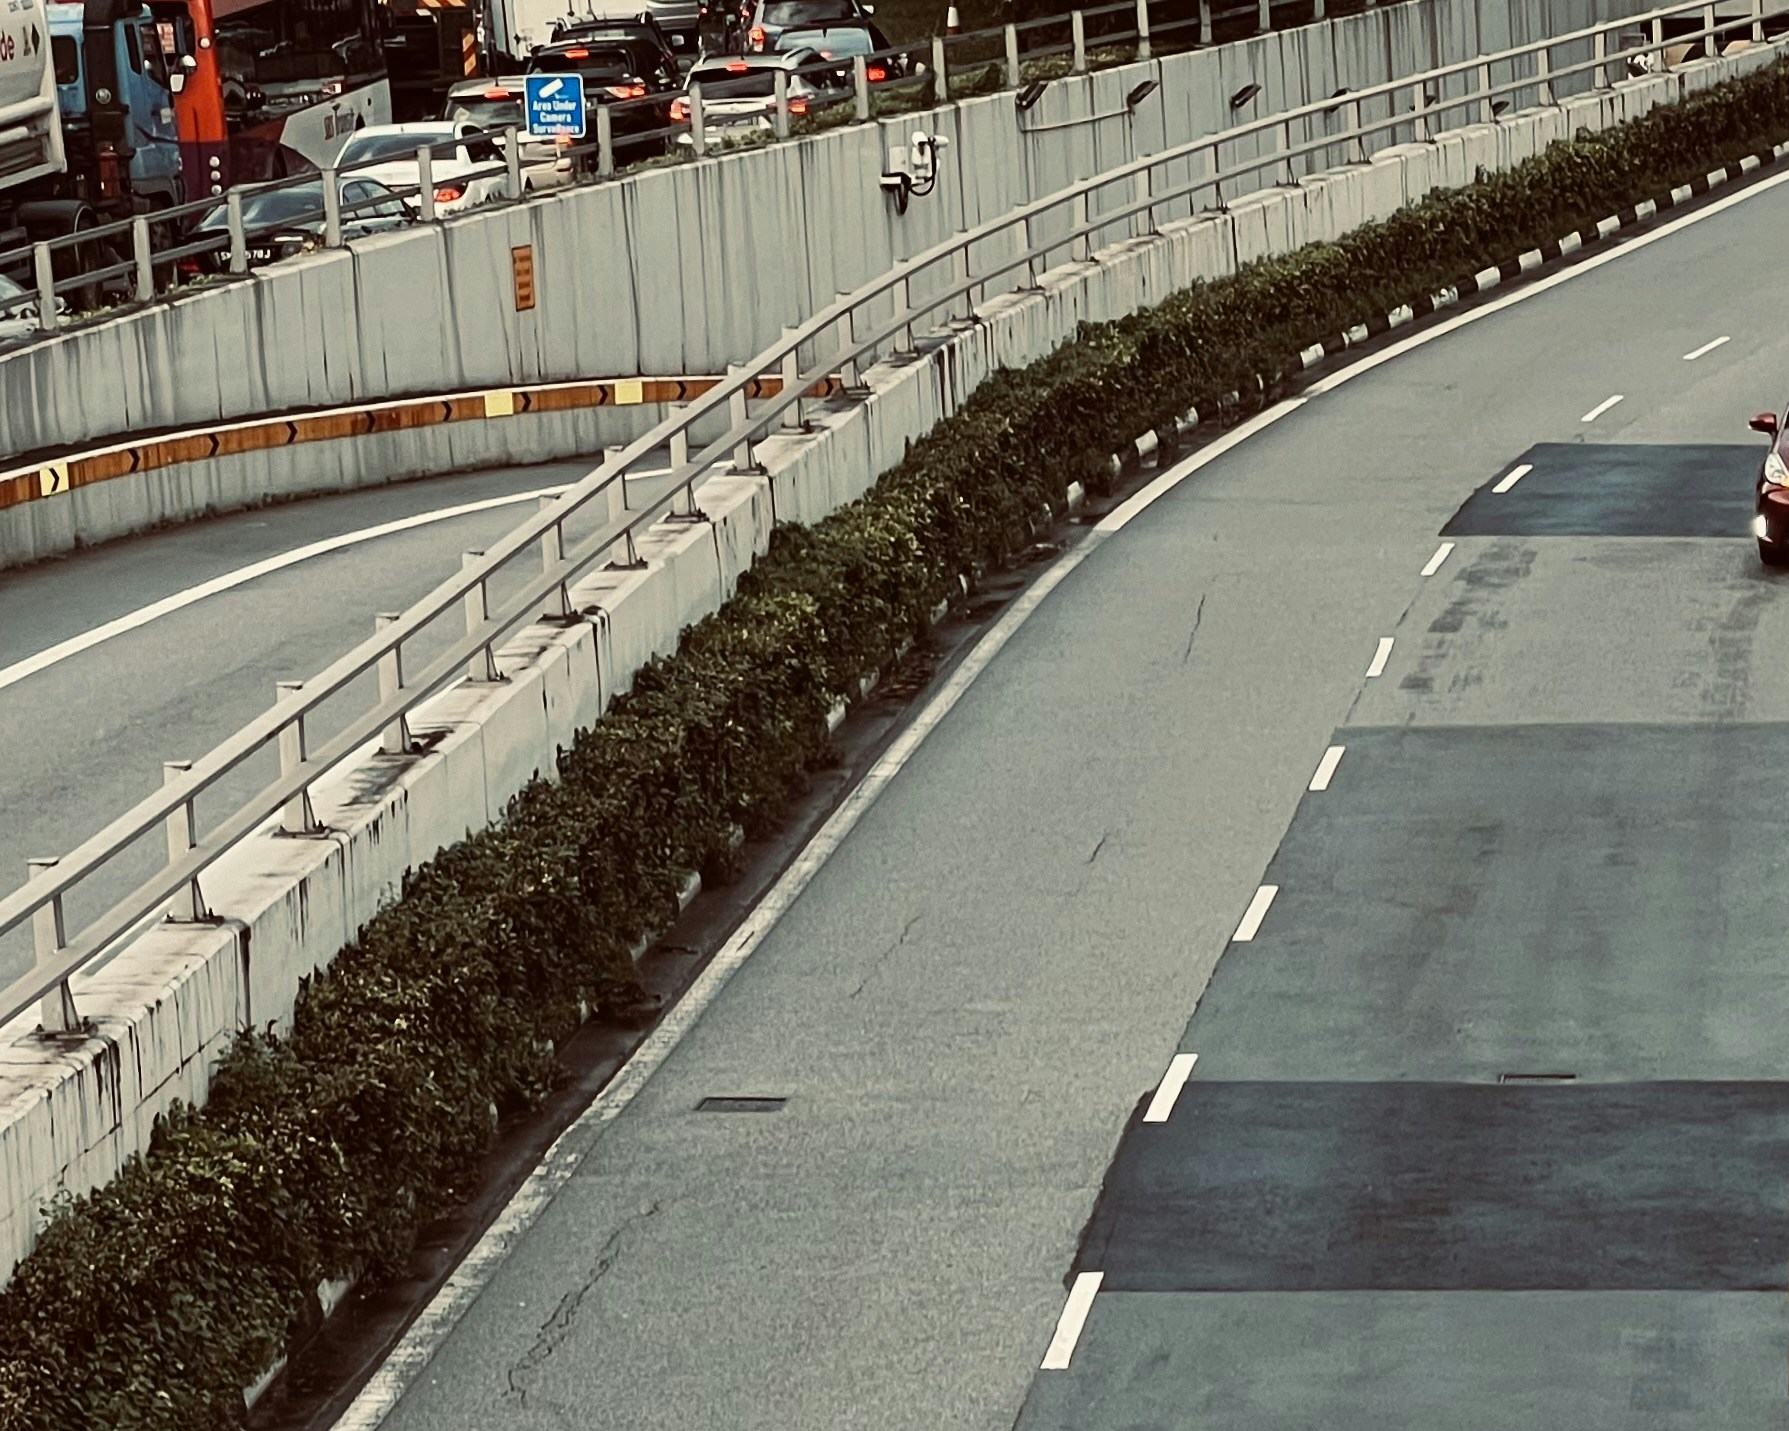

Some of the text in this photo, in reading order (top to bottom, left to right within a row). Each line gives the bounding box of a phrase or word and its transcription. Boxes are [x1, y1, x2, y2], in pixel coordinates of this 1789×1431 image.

[532, 99, 577, 111] Area Under
[540, 111, 572, 122] Camera
